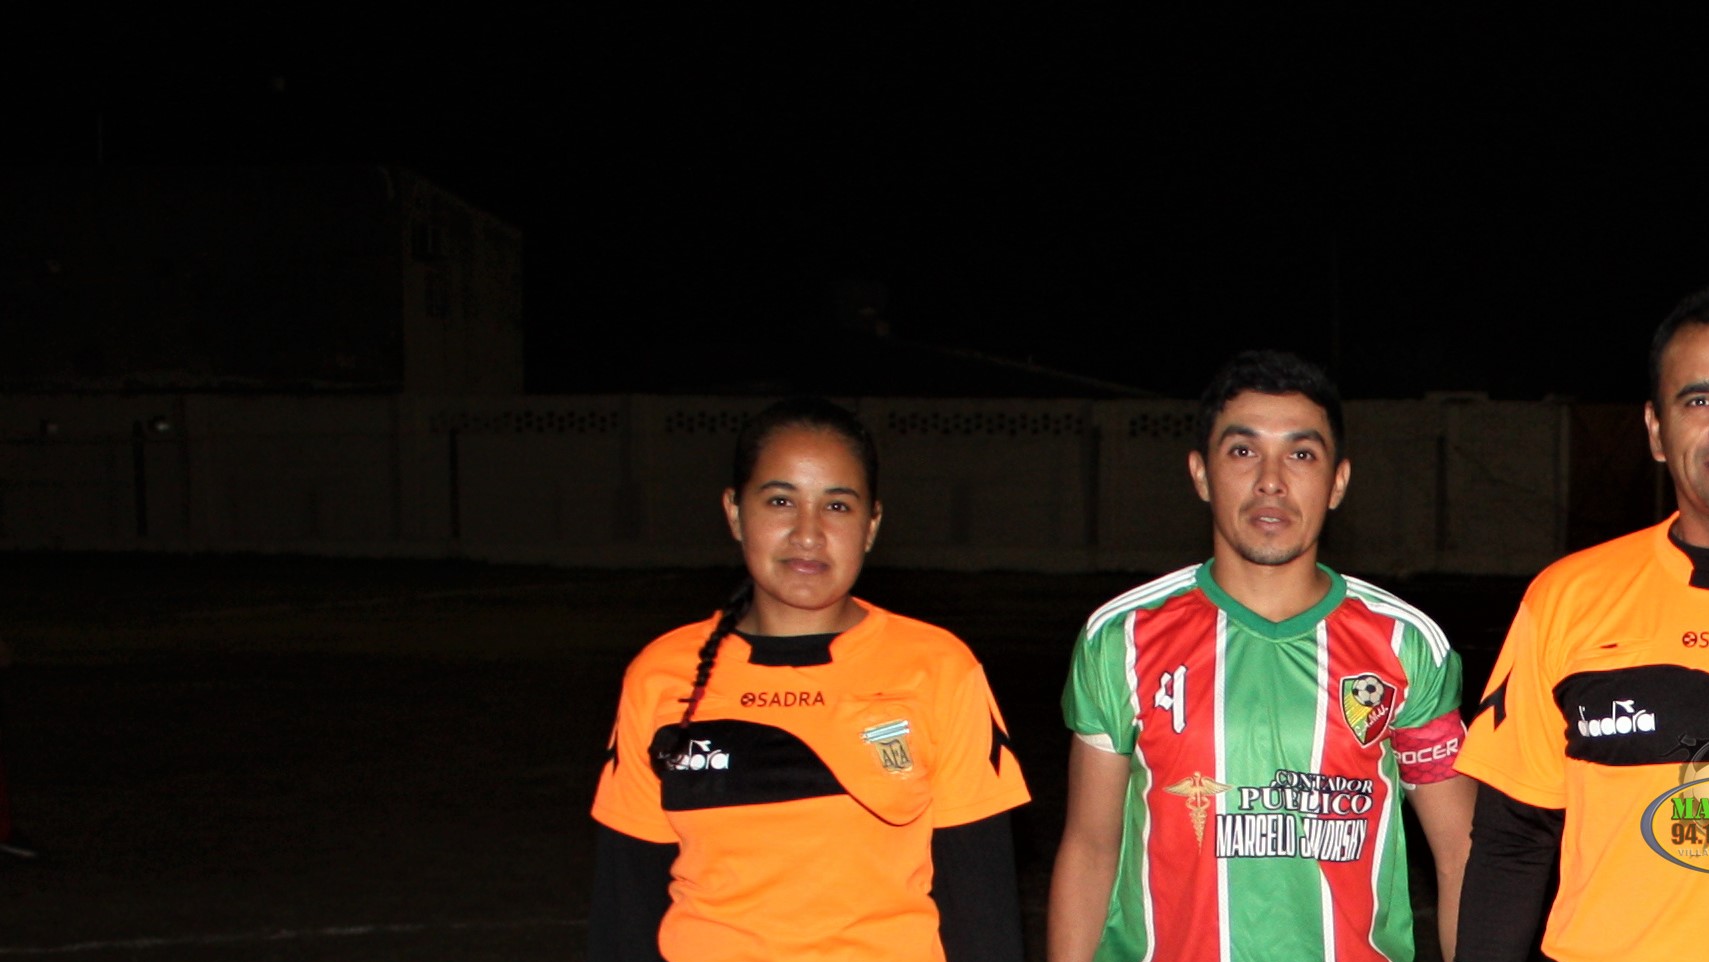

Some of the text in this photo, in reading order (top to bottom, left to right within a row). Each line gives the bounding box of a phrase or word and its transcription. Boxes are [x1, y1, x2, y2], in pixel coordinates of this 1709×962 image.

[757, 691, 826, 707] SADRA
[1154, 664, 1187, 734] 4
[1275, 769, 1374, 794] CONTADOR
[1216, 813, 1296, 858] MARCELO
